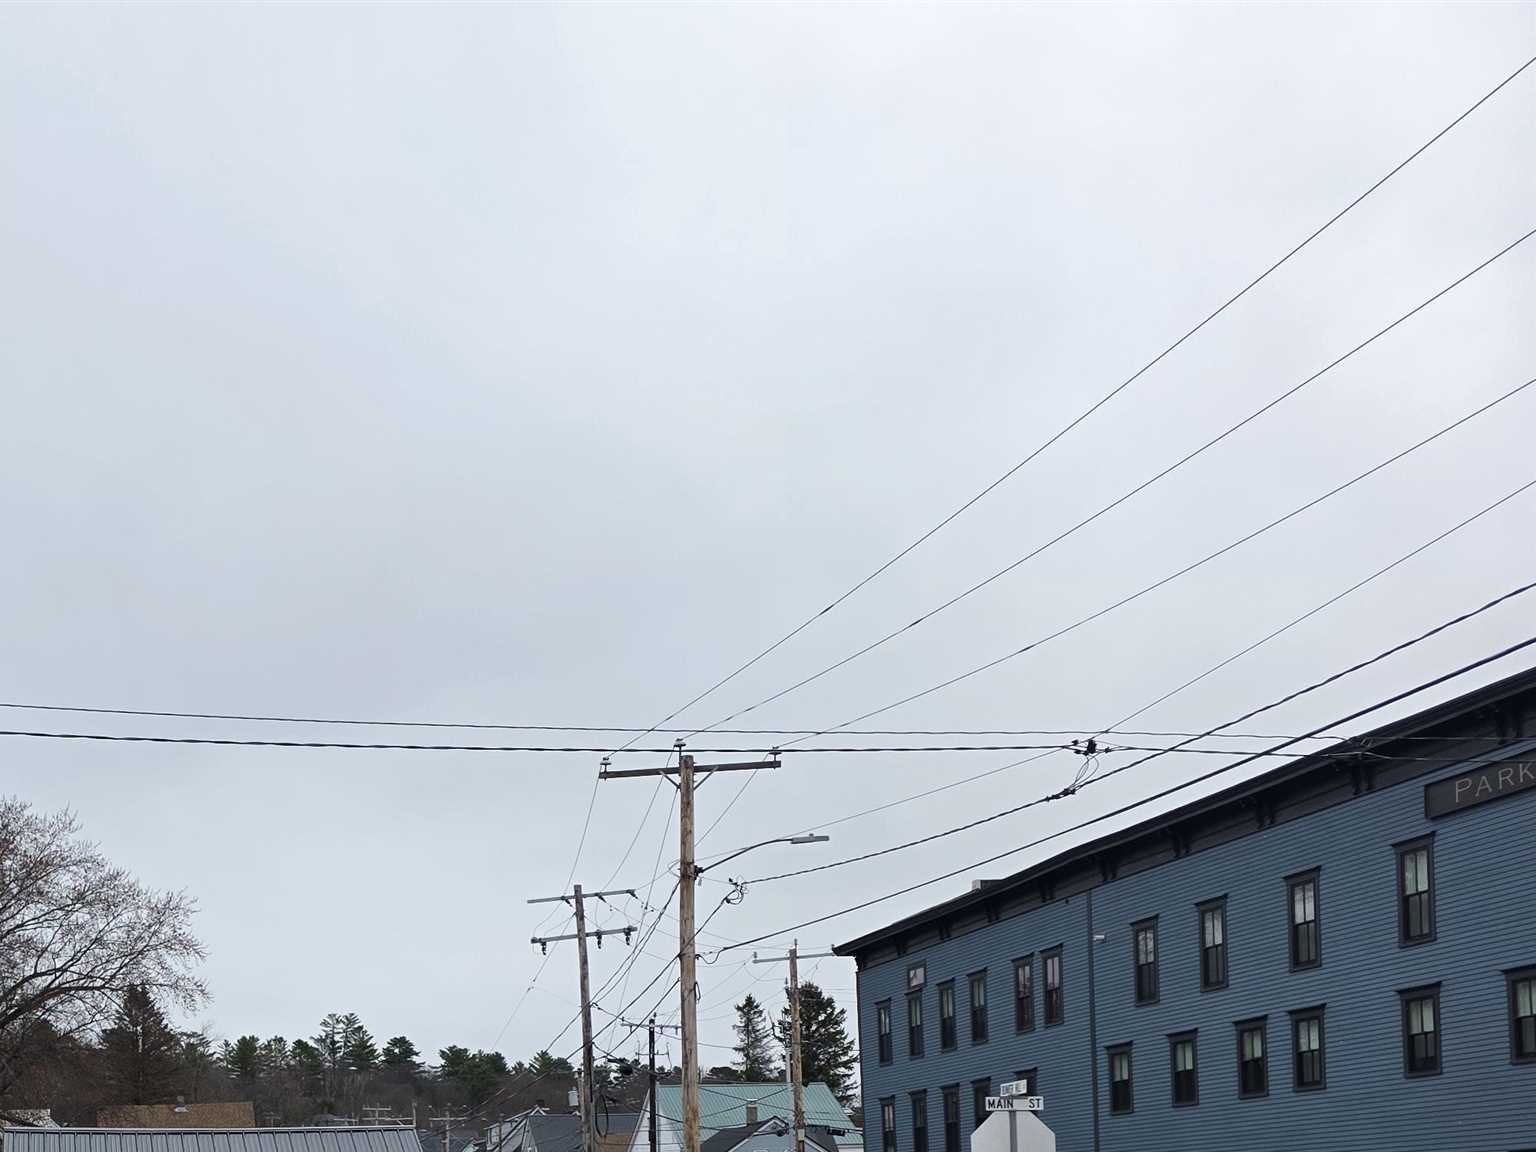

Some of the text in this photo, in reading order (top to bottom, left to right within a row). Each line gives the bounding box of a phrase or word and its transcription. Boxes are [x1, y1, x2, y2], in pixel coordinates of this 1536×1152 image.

[1455, 763, 1535, 803] PARK
[987, 1098, 1041, 1109] MAIN ST
